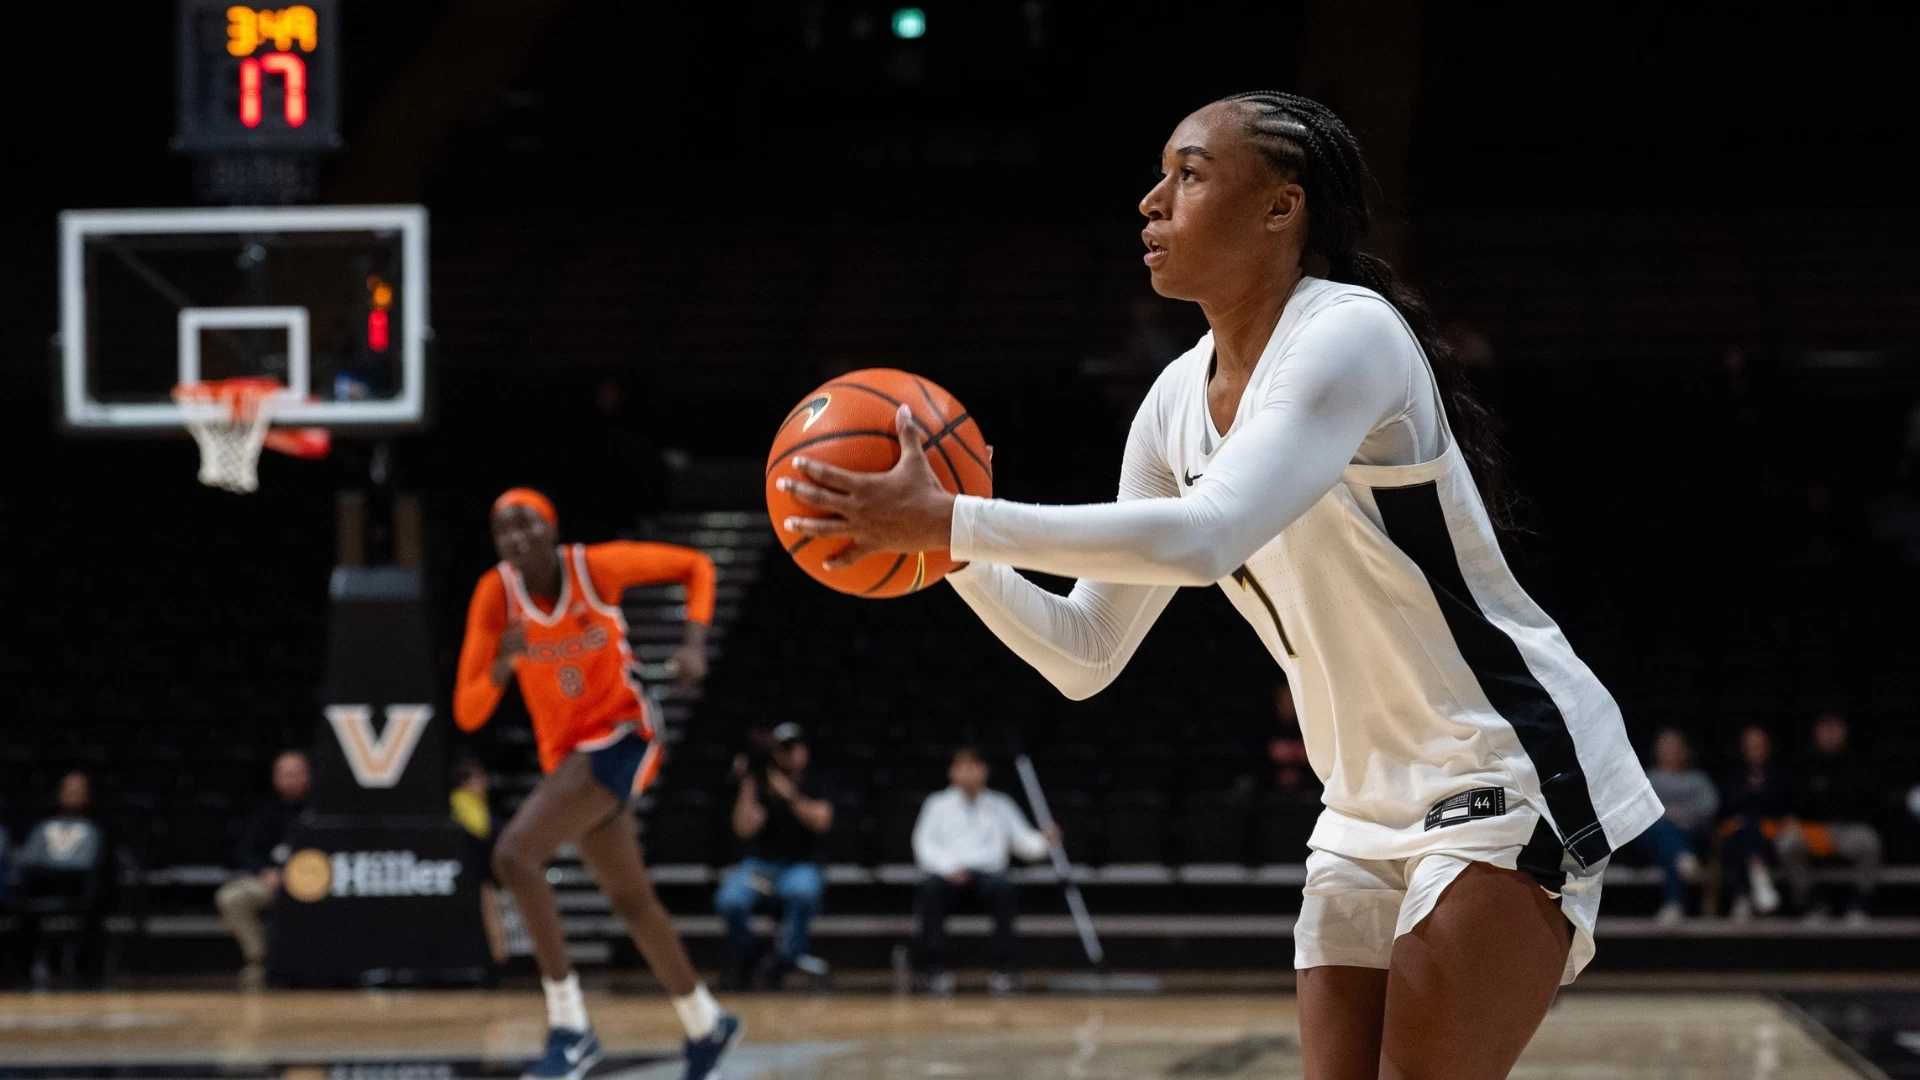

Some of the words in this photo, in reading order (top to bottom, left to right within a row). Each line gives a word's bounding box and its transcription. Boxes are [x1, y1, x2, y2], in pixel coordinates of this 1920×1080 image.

[240, 52, 307, 129] 17
[323, 703, 434, 788] V
[1474, 796, 1490, 809] 44
[331, 850, 462, 897] Hiller
